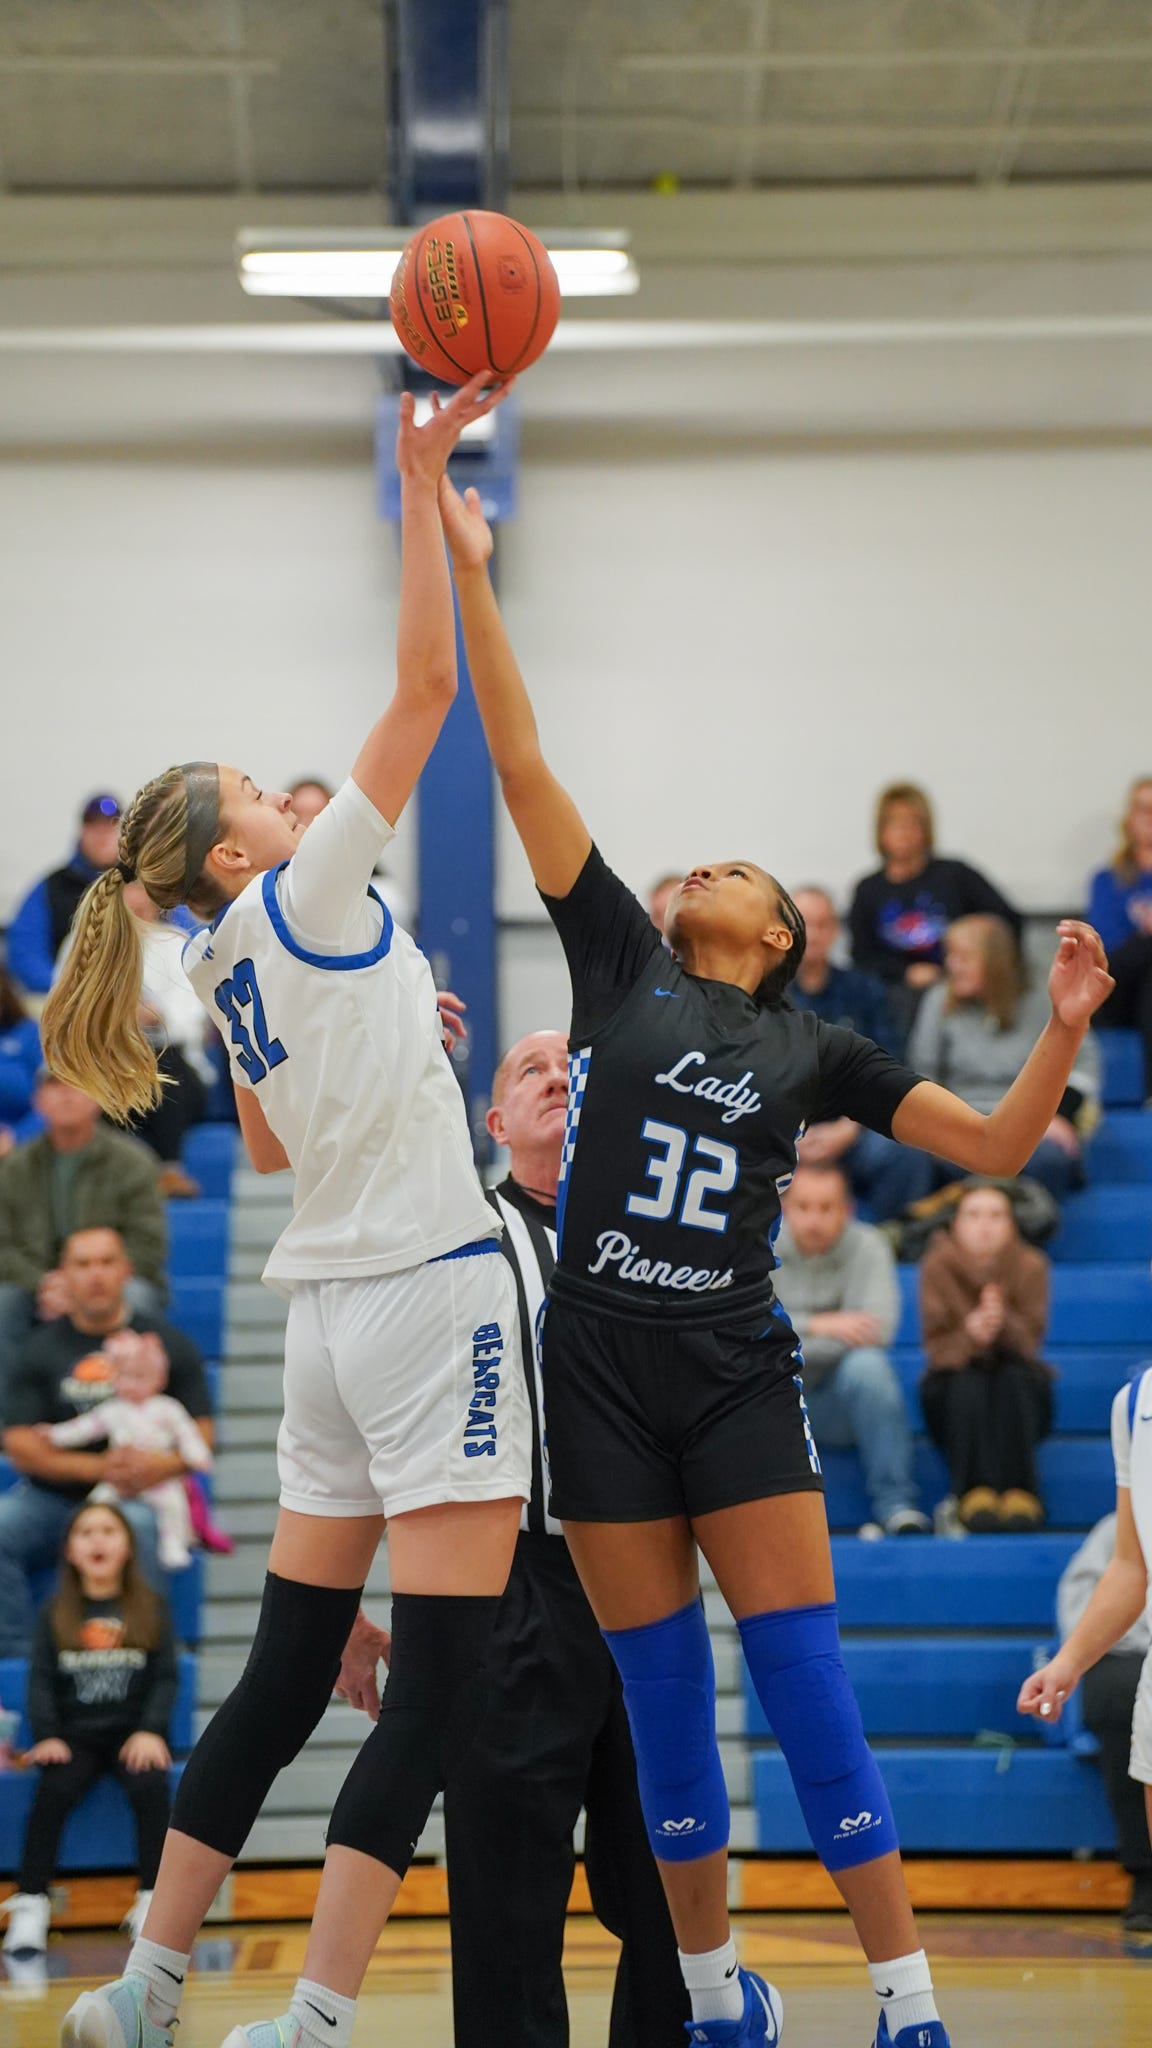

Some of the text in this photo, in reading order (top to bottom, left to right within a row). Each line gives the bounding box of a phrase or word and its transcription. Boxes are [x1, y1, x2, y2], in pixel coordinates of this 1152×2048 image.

[214, 957, 289, 1085] 32
[655, 1051, 761, 1123] Lady
[625, 1117, 739, 1233] 32
[463, 1322, 504, 1458] BEARCATS
